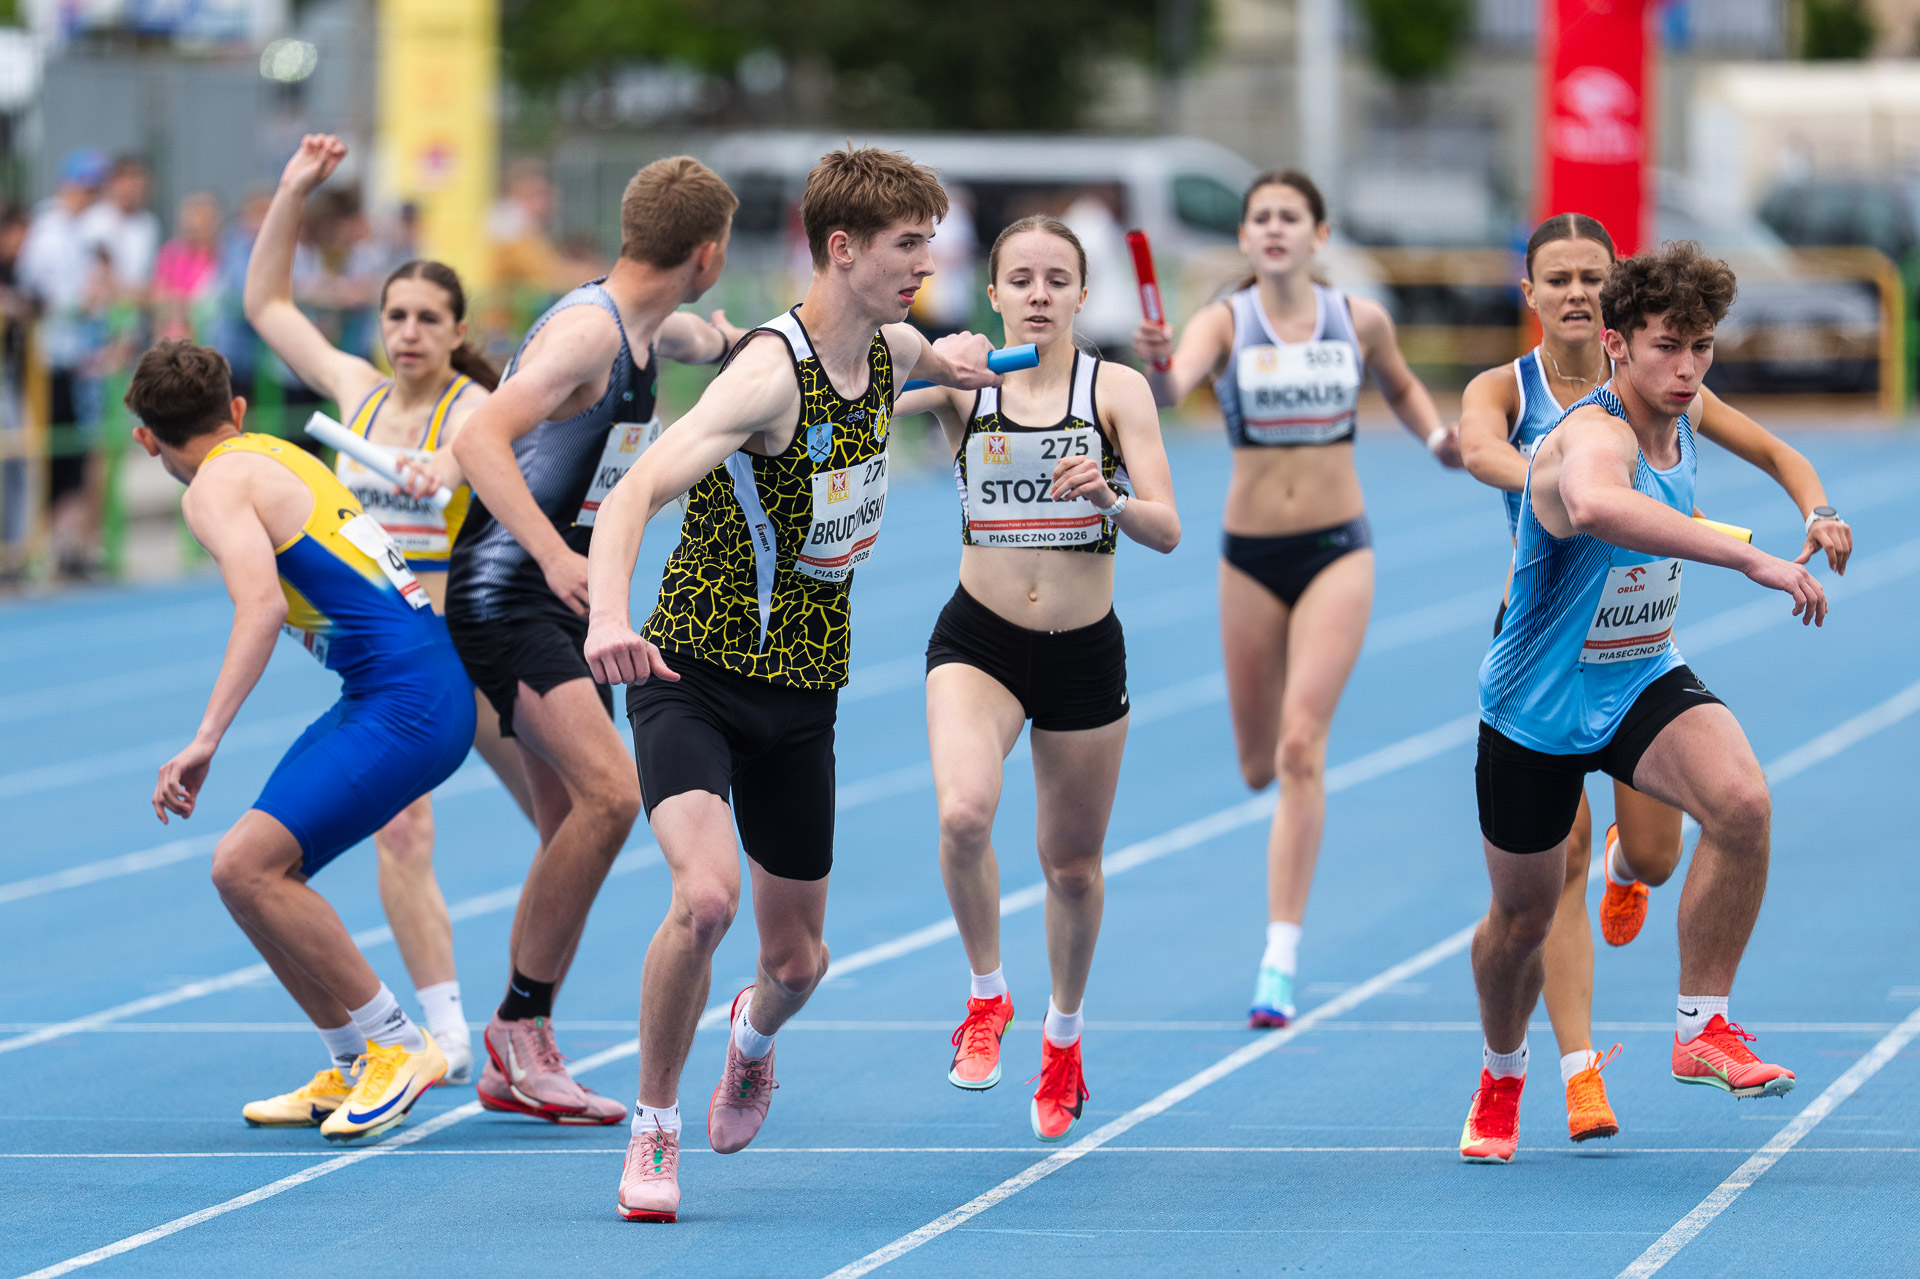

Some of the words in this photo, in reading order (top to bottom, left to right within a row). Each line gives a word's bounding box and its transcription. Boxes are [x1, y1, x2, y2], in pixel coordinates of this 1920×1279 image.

[846, 410, 865, 423] esa
[1041, 435, 1089, 460] 275
[981, 473, 1089, 504] STOŻ
[989, 532, 1056, 543] PIASECZNO
[1059, 531, 1087, 541] 2026
[853, 549, 870, 564] 2026
[1617, 584, 1645, 594] ORLEN
[1599, 646, 1655, 660] PIASECZNO
